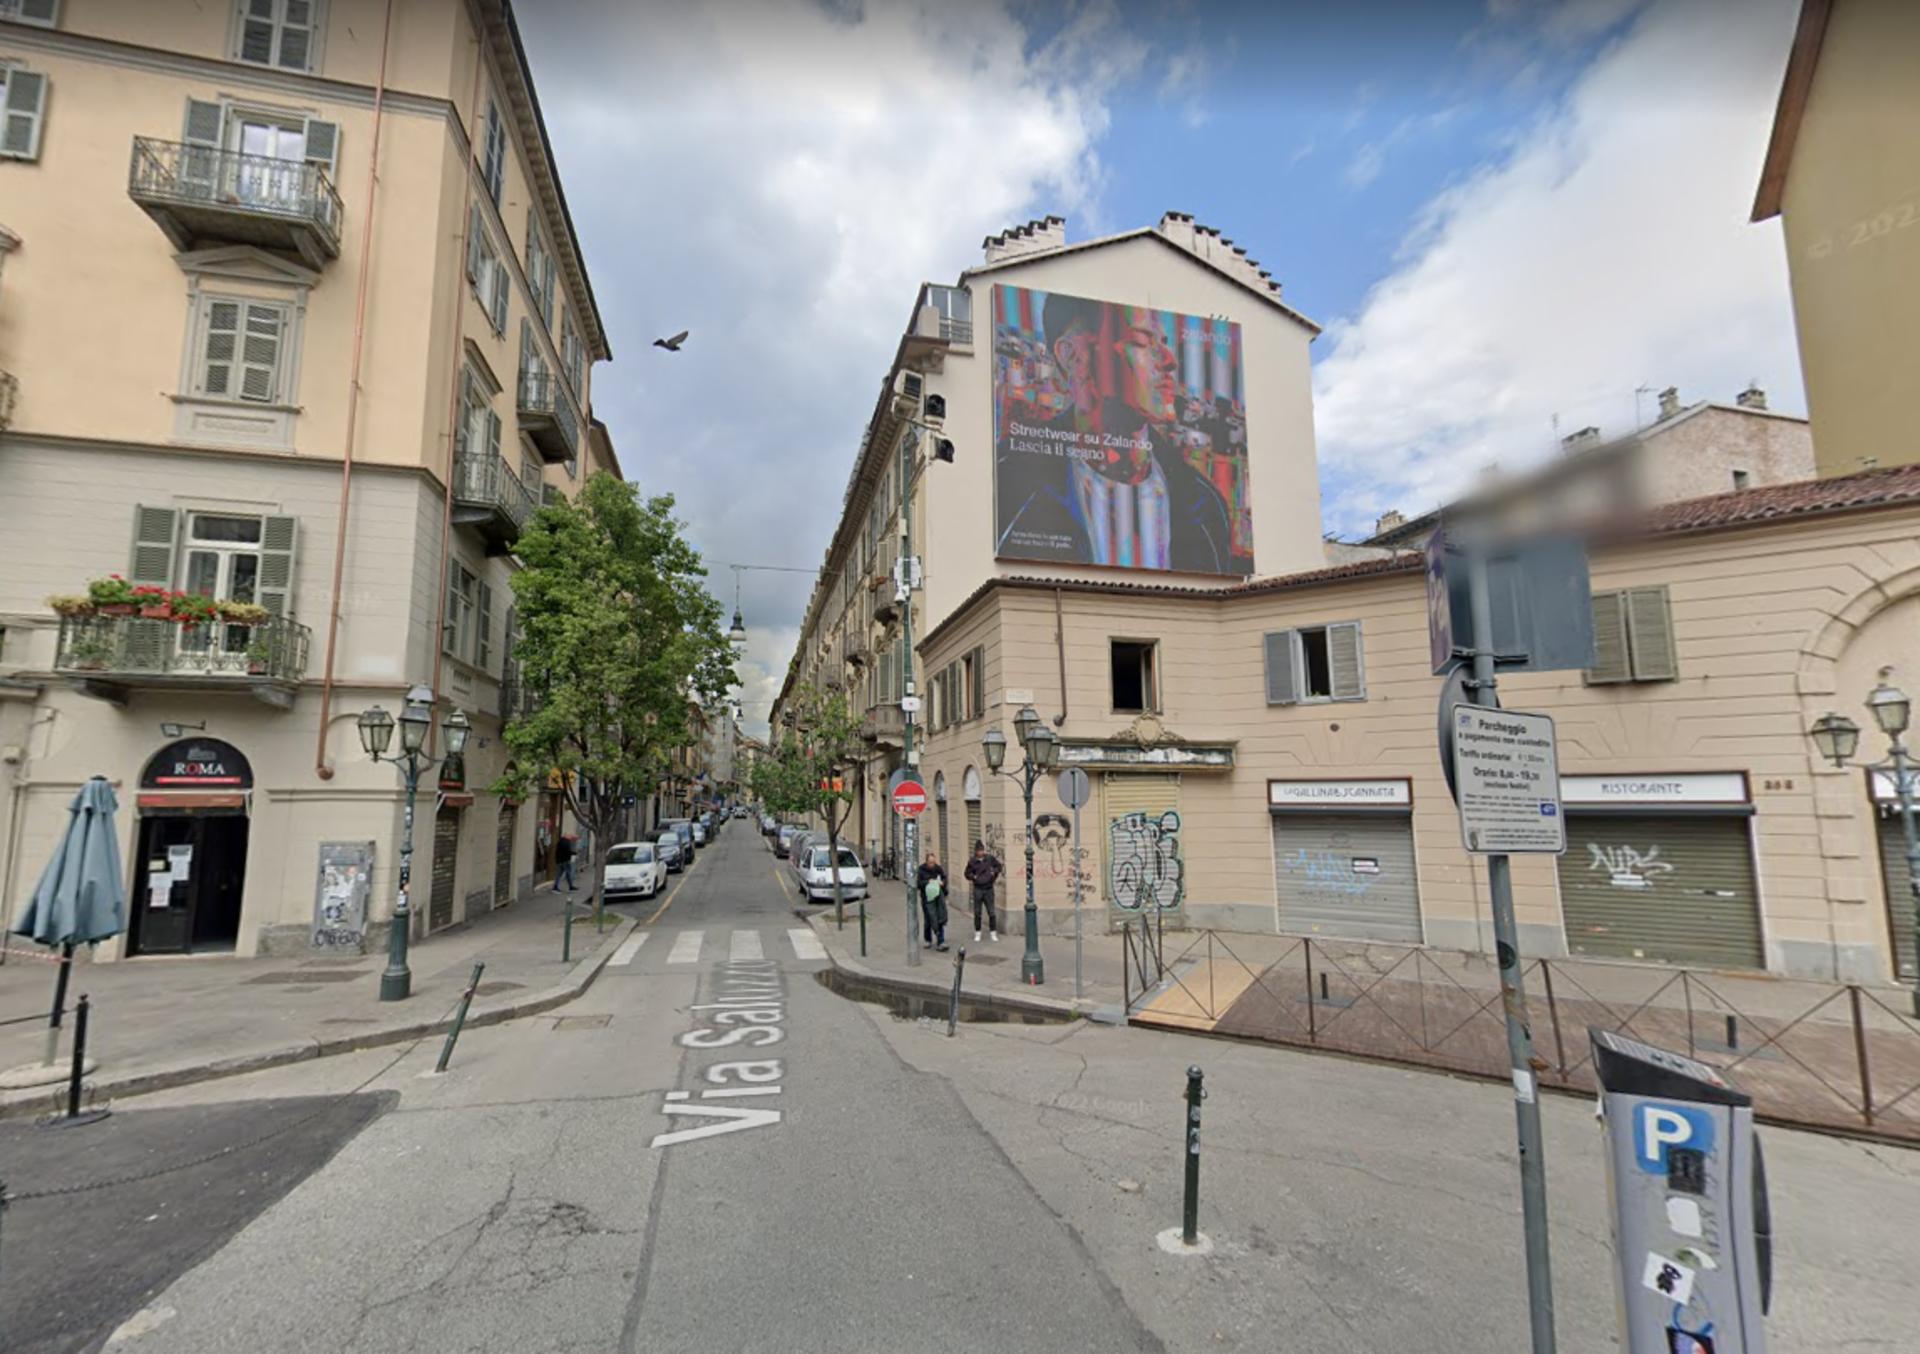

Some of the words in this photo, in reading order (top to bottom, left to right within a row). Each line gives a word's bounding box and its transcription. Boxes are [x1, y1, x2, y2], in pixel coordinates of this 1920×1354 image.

[1009, 421, 1081, 443] Streetwear
[1083, 433, 1100, 445] su
[1102, 432, 1153, 451] Zalando
[1009, 437, 1052, 455] Lascia
[1054, 442, 1064, 457] il
[1065, 446, 1105, 461] segno
[1478, 719, 1528, 735] Parcheggio
[173, 761, 226, 776] ROMA
[1600, 782, 1683, 795] RISTORANTE
[1642, 1105, 1693, 1162] P
